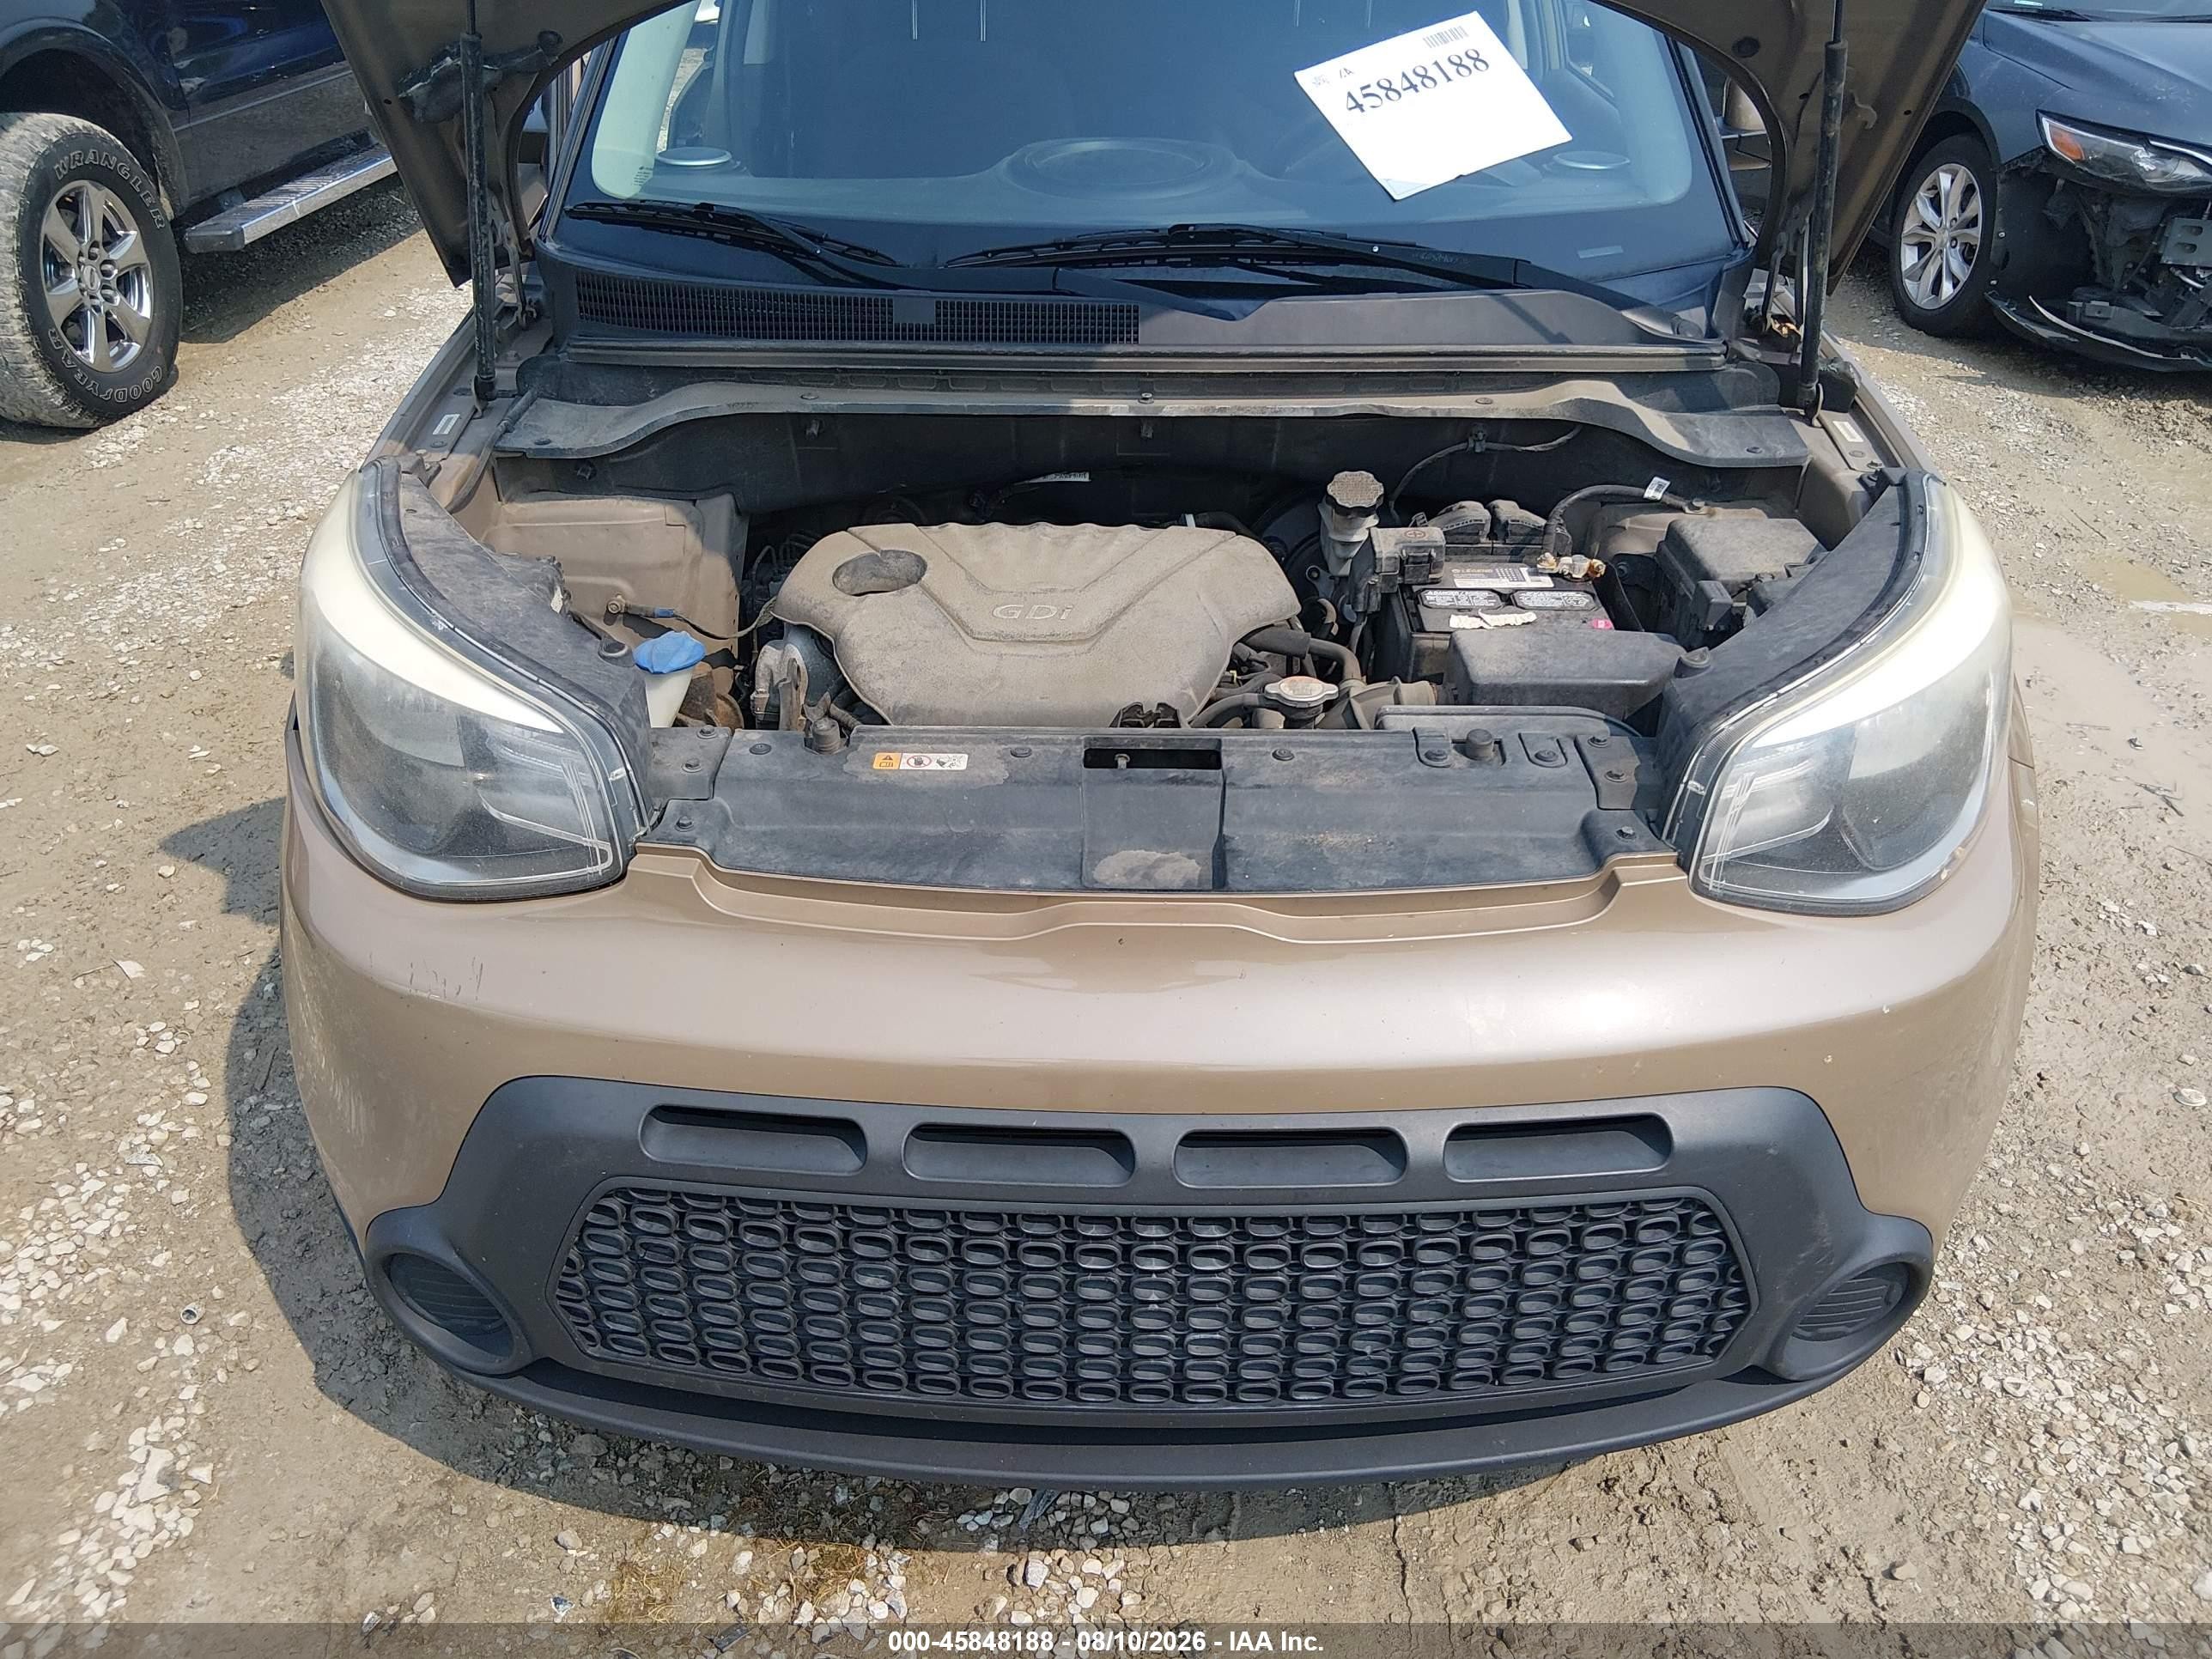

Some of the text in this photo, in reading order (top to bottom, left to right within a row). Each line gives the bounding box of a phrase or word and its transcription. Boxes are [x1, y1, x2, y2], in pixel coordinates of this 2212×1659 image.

[1346, 48, 1491, 113] 45848188
[54, 149, 166, 230] WRANGLER
[48, 328, 162, 403] GOODYEAR
